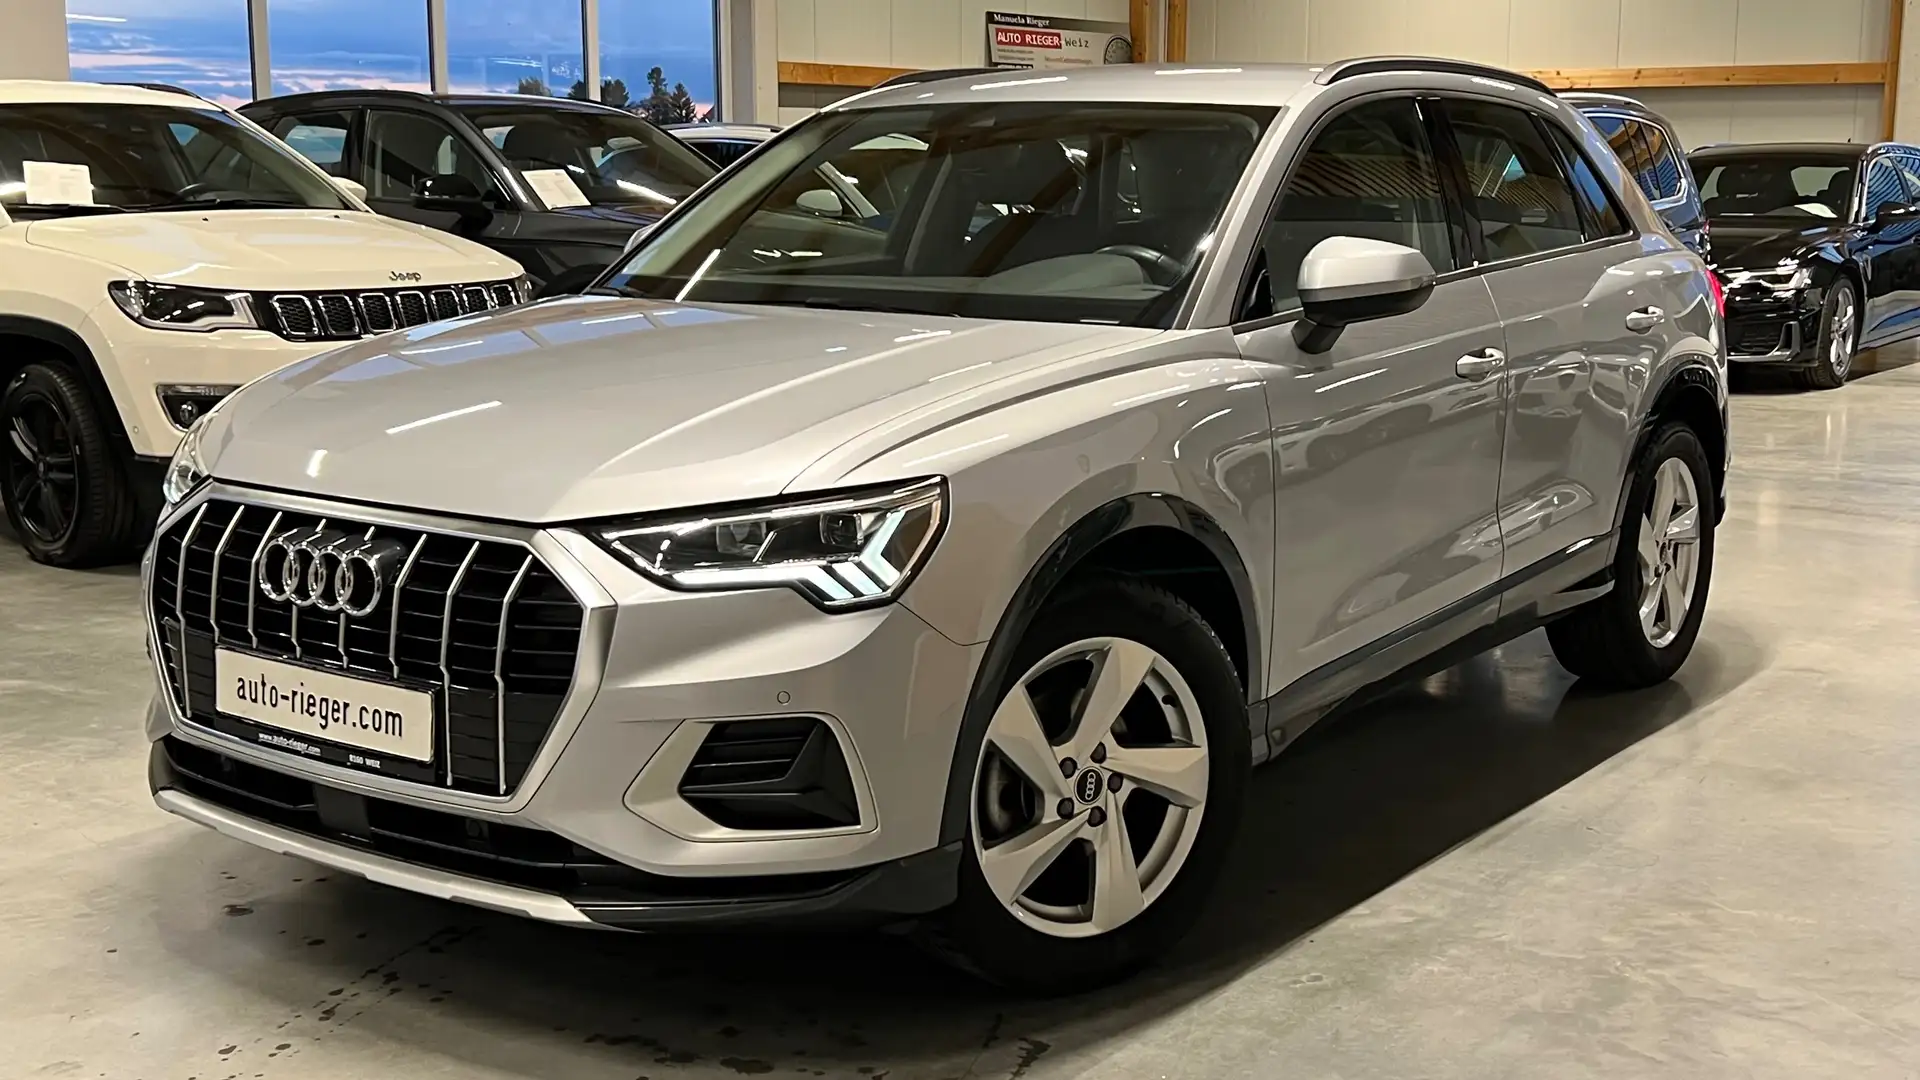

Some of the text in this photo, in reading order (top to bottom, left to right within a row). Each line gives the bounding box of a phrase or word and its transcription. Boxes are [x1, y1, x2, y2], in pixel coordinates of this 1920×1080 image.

[994, 13, 1050, 28] Manuela Rieger
[997, 31, 1089, 48] AUTO RIEGER Weiz
[389, 270, 421, 282] Jeep
[237, 673, 402, 737] auto-rieger.com
